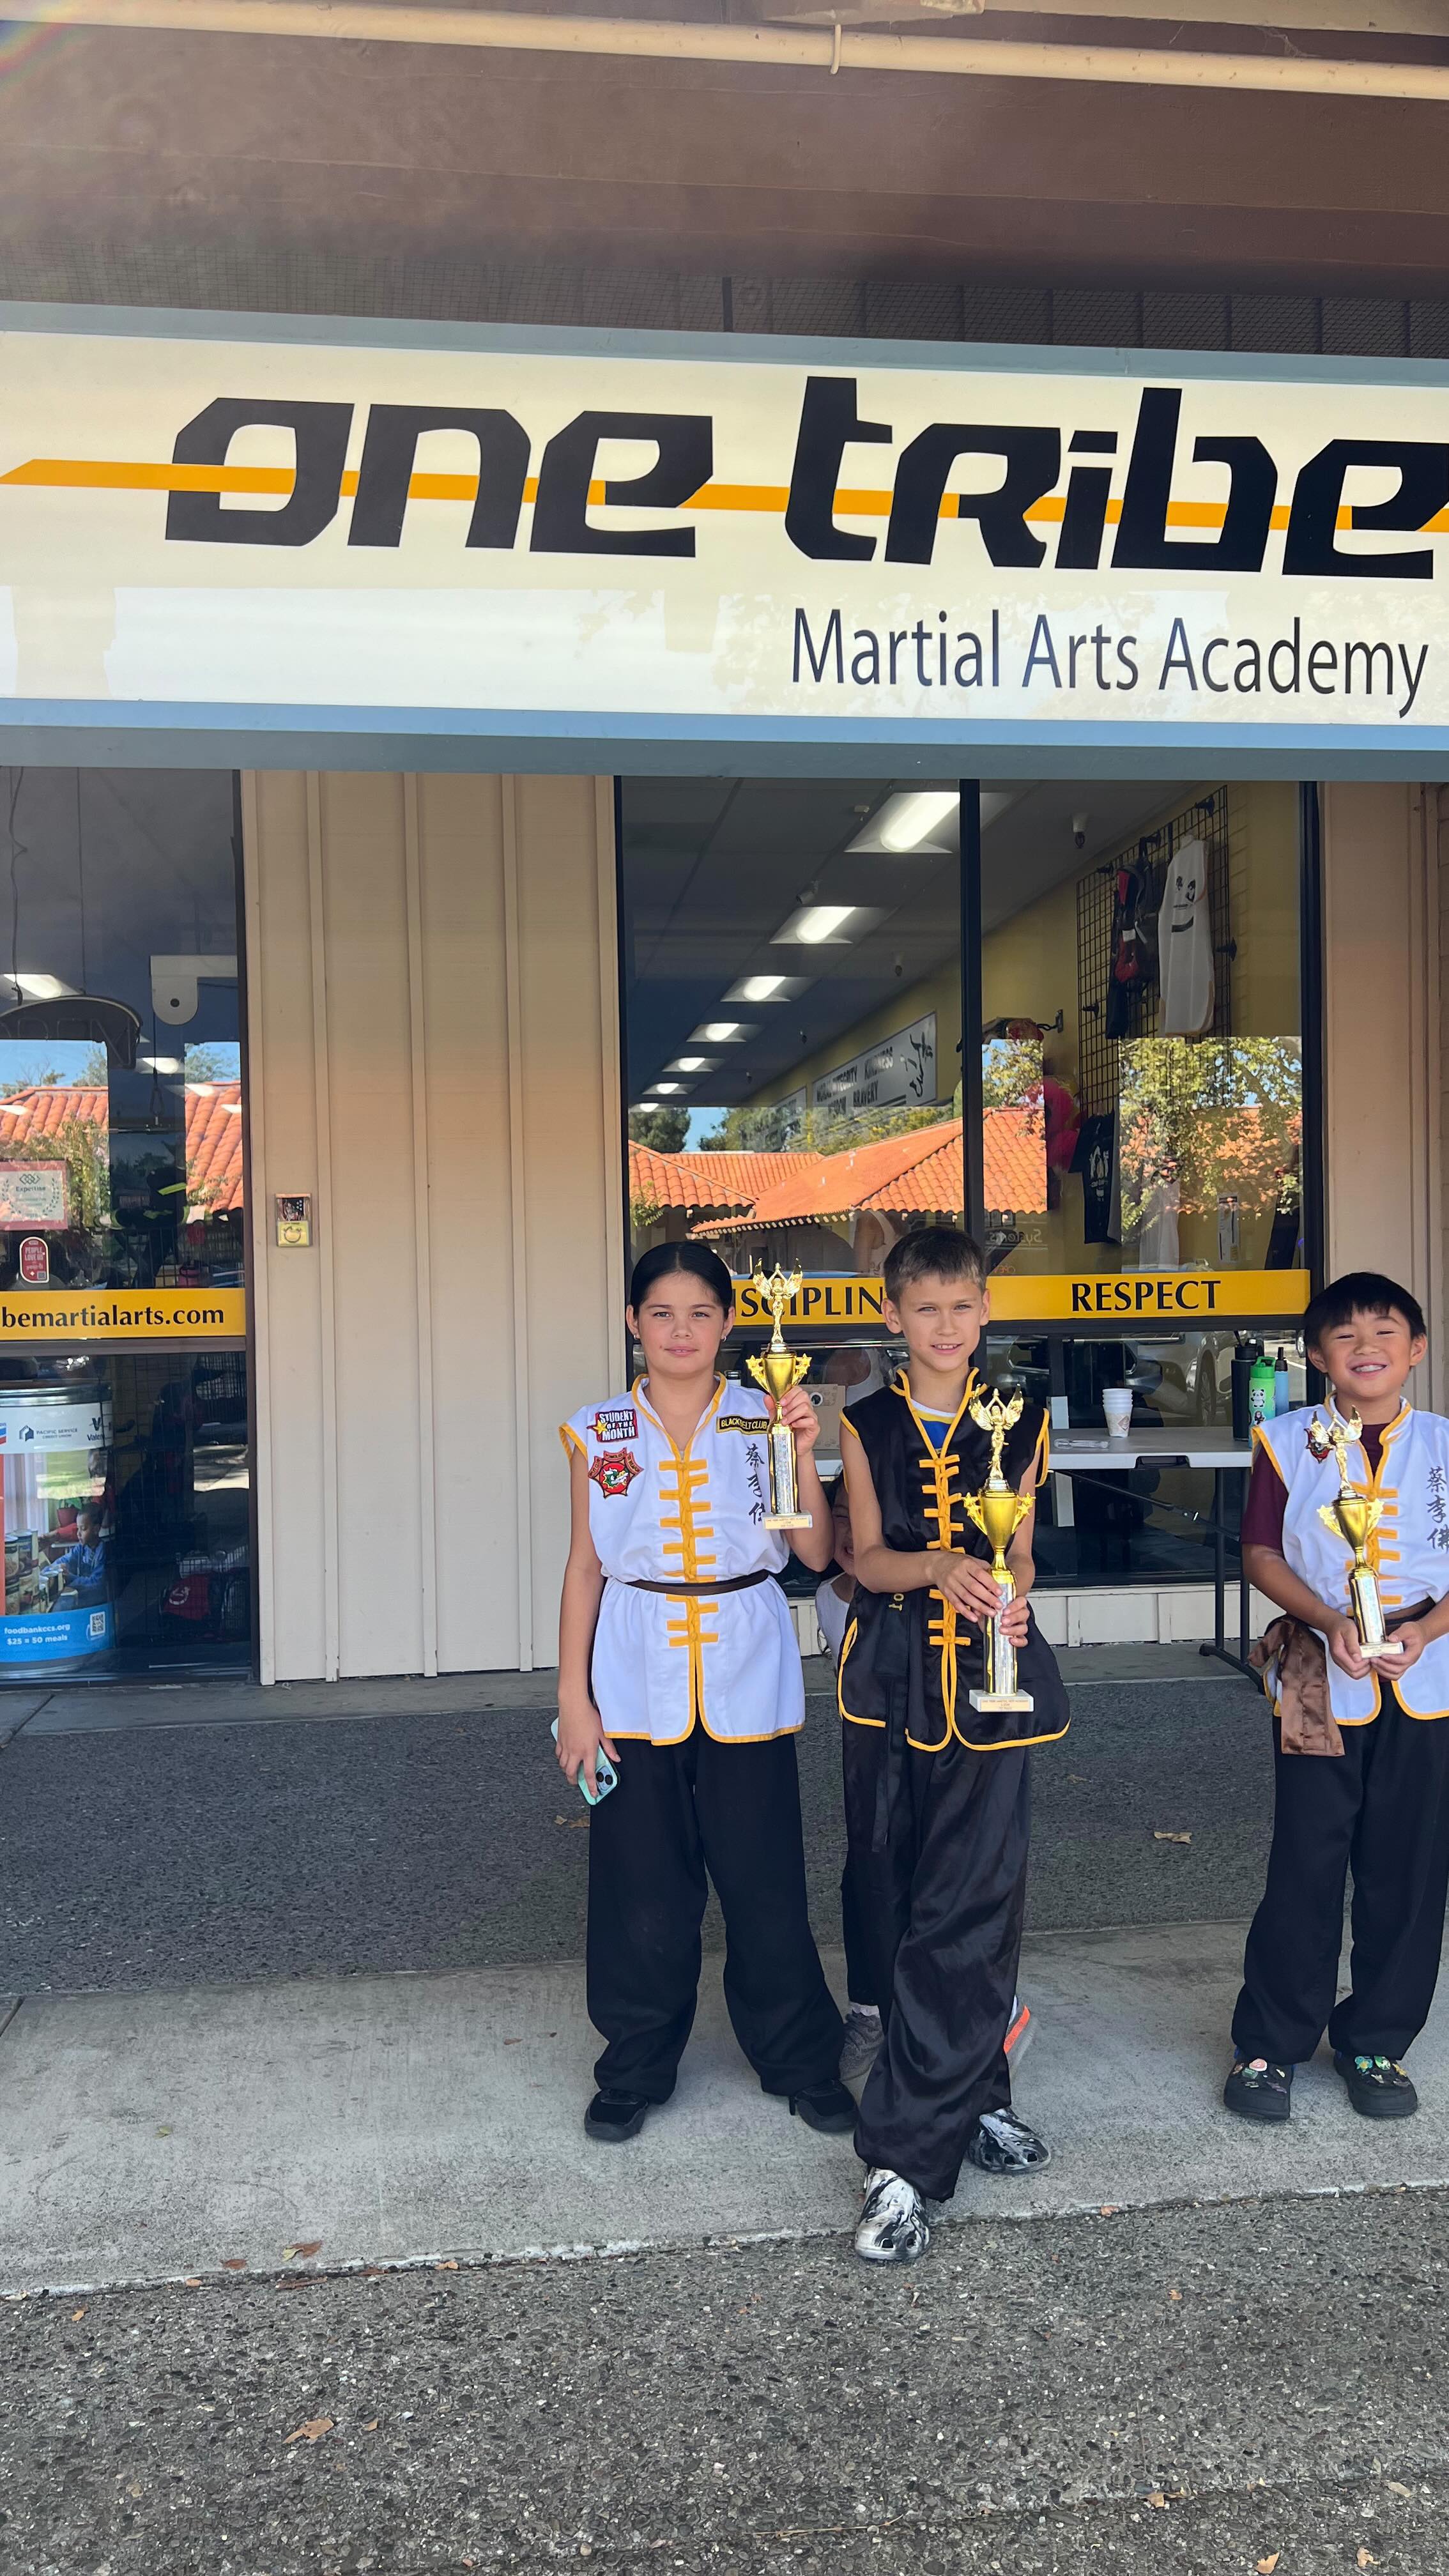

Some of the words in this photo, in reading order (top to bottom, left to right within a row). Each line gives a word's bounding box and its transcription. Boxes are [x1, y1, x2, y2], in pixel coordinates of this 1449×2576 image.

[165, 397, 713, 557] one
[792, 608, 999, 687] Martial
[1022, 614, 1138, 691] Arts
[1159, 617, 1429, 718] Academy
[732, 1286, 883, 1317] ISCIPLIN
[1072, 1280, 1221, 1312] RESPECT
[2, 1305, 224, 1328] bemartialarts.com
[599, 1411, 633, 1423] STUDENT
[721, 1418, 740, 1427] BLACK
[752, 1421, 767, 1429] CLUB
[602, 1427, 635, 1441] MONTH
[4, 1623, 71, 1634] foodbankccs.org
[7, 1637, 22, 1646] $25
[45, 1634, 68, 1643] meals
